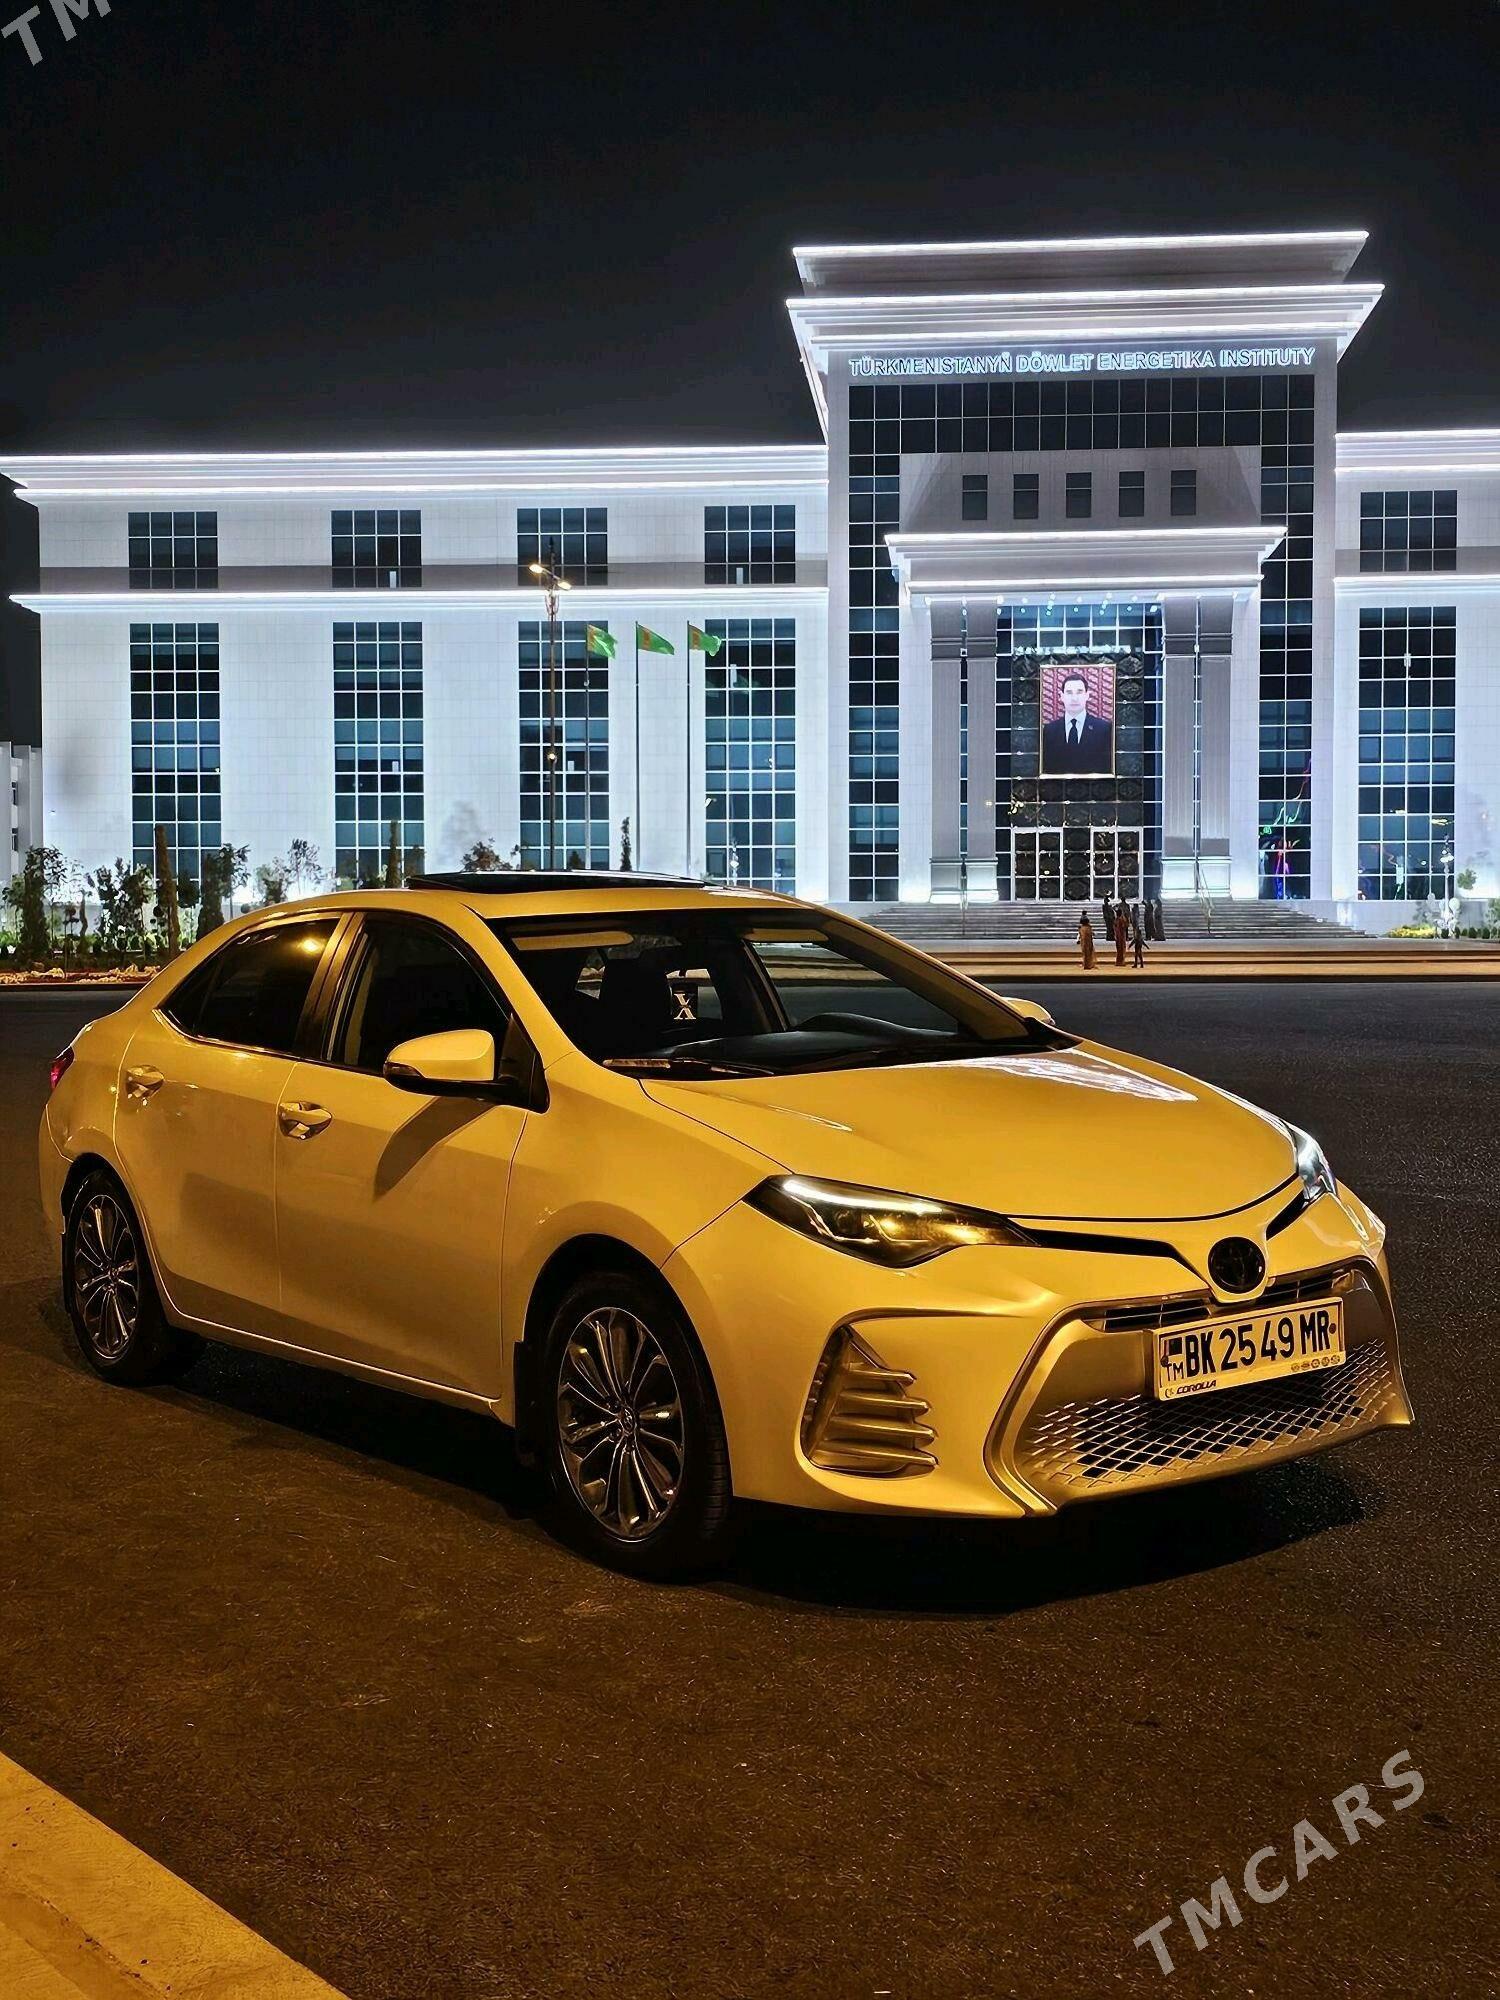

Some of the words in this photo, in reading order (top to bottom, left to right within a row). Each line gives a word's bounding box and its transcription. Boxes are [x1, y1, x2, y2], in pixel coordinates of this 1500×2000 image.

[1016, 351, 1094, 373] DÖWLET
[1097, 350, 1216, 371] ENERGETIKA
[1220, 347, 1315, 367] INSTITUTY
[1165, 1361, 1184, 1381] TM
[1177, 1380, 1216, 1394] COROLLA
